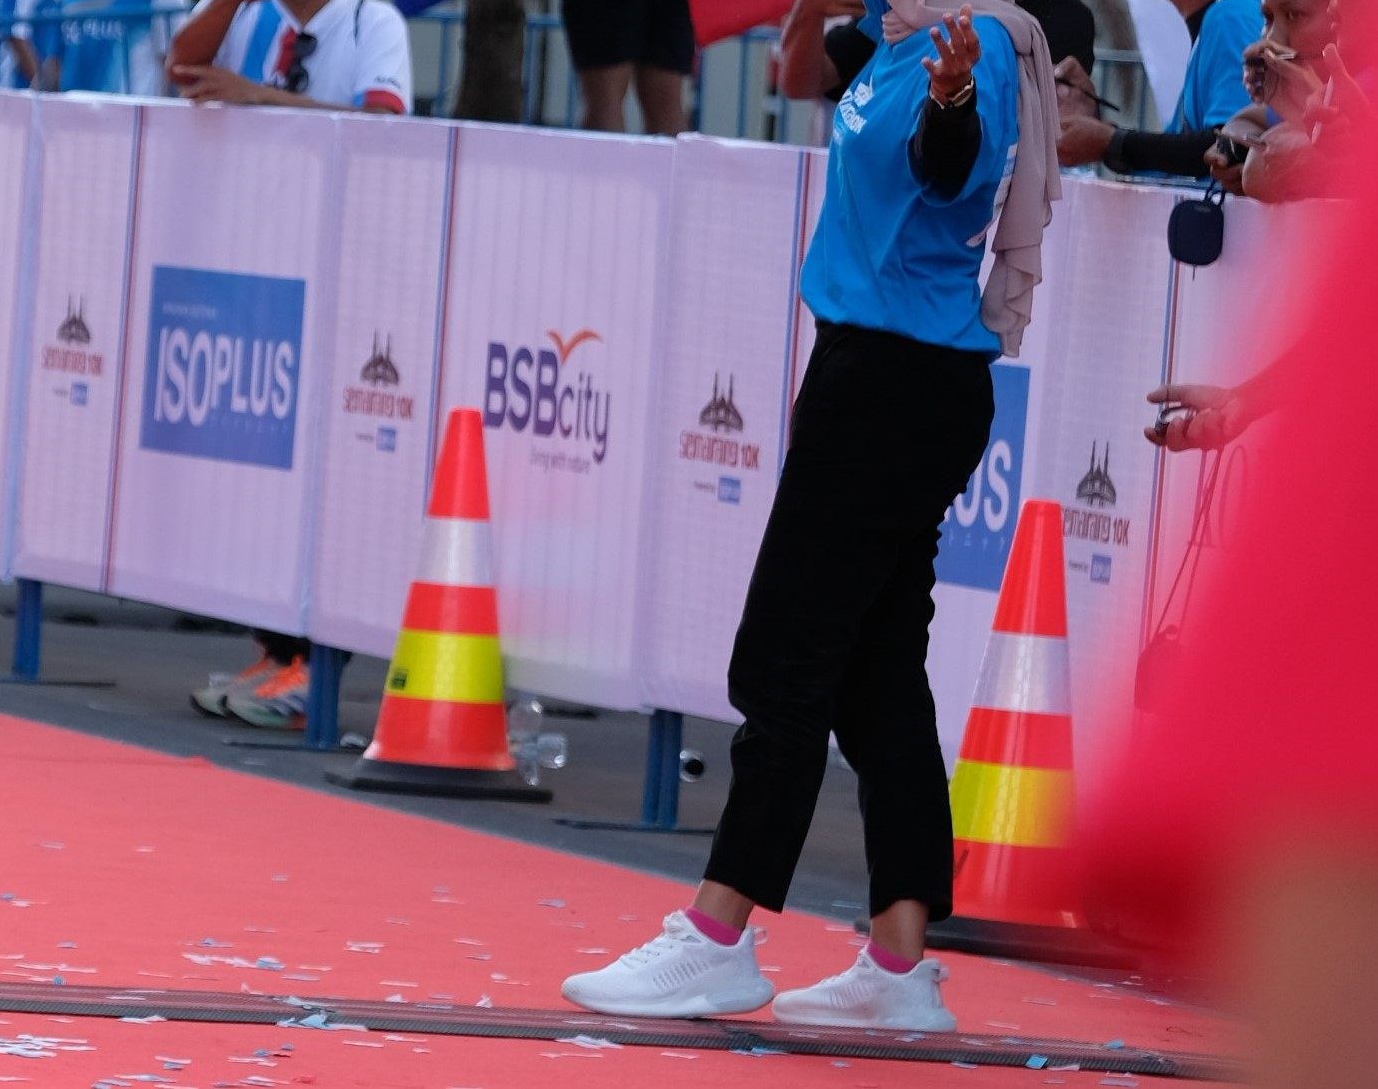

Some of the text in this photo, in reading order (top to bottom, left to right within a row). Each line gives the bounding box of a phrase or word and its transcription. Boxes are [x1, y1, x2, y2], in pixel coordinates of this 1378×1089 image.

[153, 327, 295, 428] ISOPLUS
[483, 342, 610, 465] BSBcity
[1113, 515, 1131, 547] 10K
